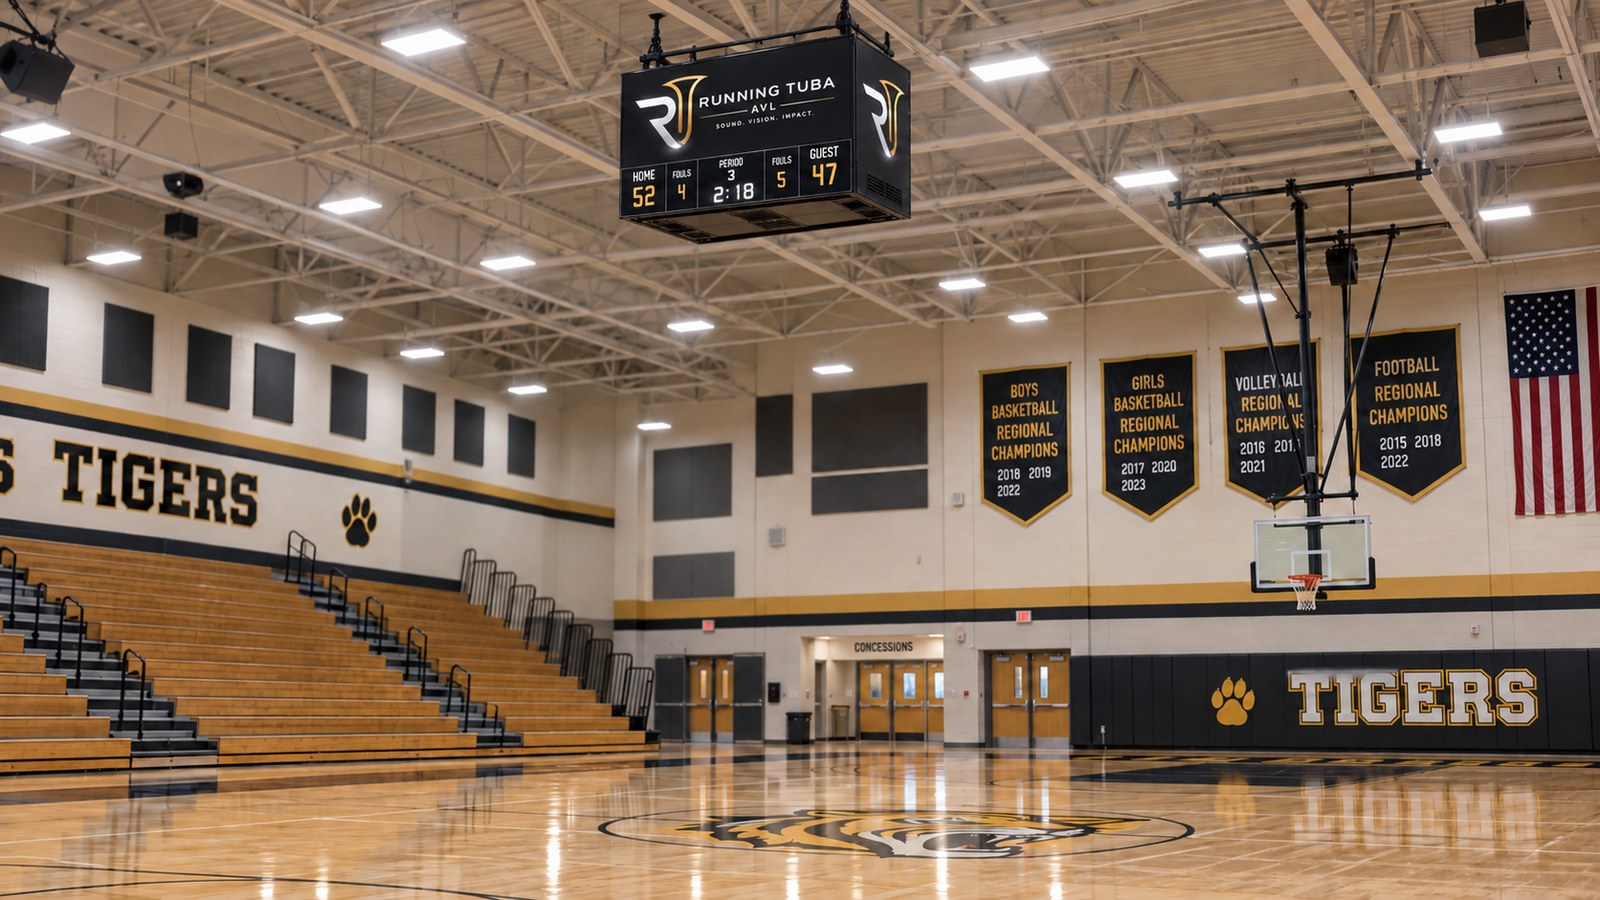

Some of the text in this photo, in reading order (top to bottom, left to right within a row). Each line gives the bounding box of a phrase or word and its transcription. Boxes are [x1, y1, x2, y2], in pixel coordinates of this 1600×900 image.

[699, 77, 835, 108] RUNNING TUBA
[751, 102, 776, 114] AVL
[715, 110, 815, 130] SOUND. VISION. IMPACT.
[772, 155, 792, 166] FOULS
[810, 145, 839, 160] GUEST
[632, 169, 656, 182] HOME
[672, 168, 692, 179] FOULS
[727, 170, 735, 181] 3
[777, 171, 786, 189] 5
[812, 162, 838, 186] 47
[632, 185, 656, 208] 52
[677, 183, 686, 200] 4
[713, 182, 754, 203] 2:18
[1375, 356, 1439, 377] FOOTBALL
[1132, 373, 1164, 390] GIRLS
[1010, 382, 1039, 399] BOYS
[1375, 381, 1440, 402] REGIONAL
[992, 400, 1059, 420] BASKETBALL
[1114, 392, 1184, 412] BASKETBALL
[1120, 414, 1179, 433] REGIONAL
[1369, 404, 1448, 426] CHAMPIONS
[997, 422, 1053, 440] REGIONAL
[1114, 434, 1185, 454] CHAMPIONS
[1240, 441, 1265, 455] 2016
[1380, 434, 1442, 450] 2015 2018
[991, 442, 1059, 461] CHAMPIONS
[1121, 460, 1177, 475] 2017 2020
[1240, 459, 1265, 473] 2021
[1381, 454, 1409, 469] 2022
[997, 466, 1051, 481] 2018 2019
[53, 438, 259, 529] TIGERS
[997, 484, 1021, 497] 2022
[1121, 479, 1146, 491] 2023
[854, 641, 913, 652] CONCESSIONS
[1288, 668, 1539, 726] TIGERS
